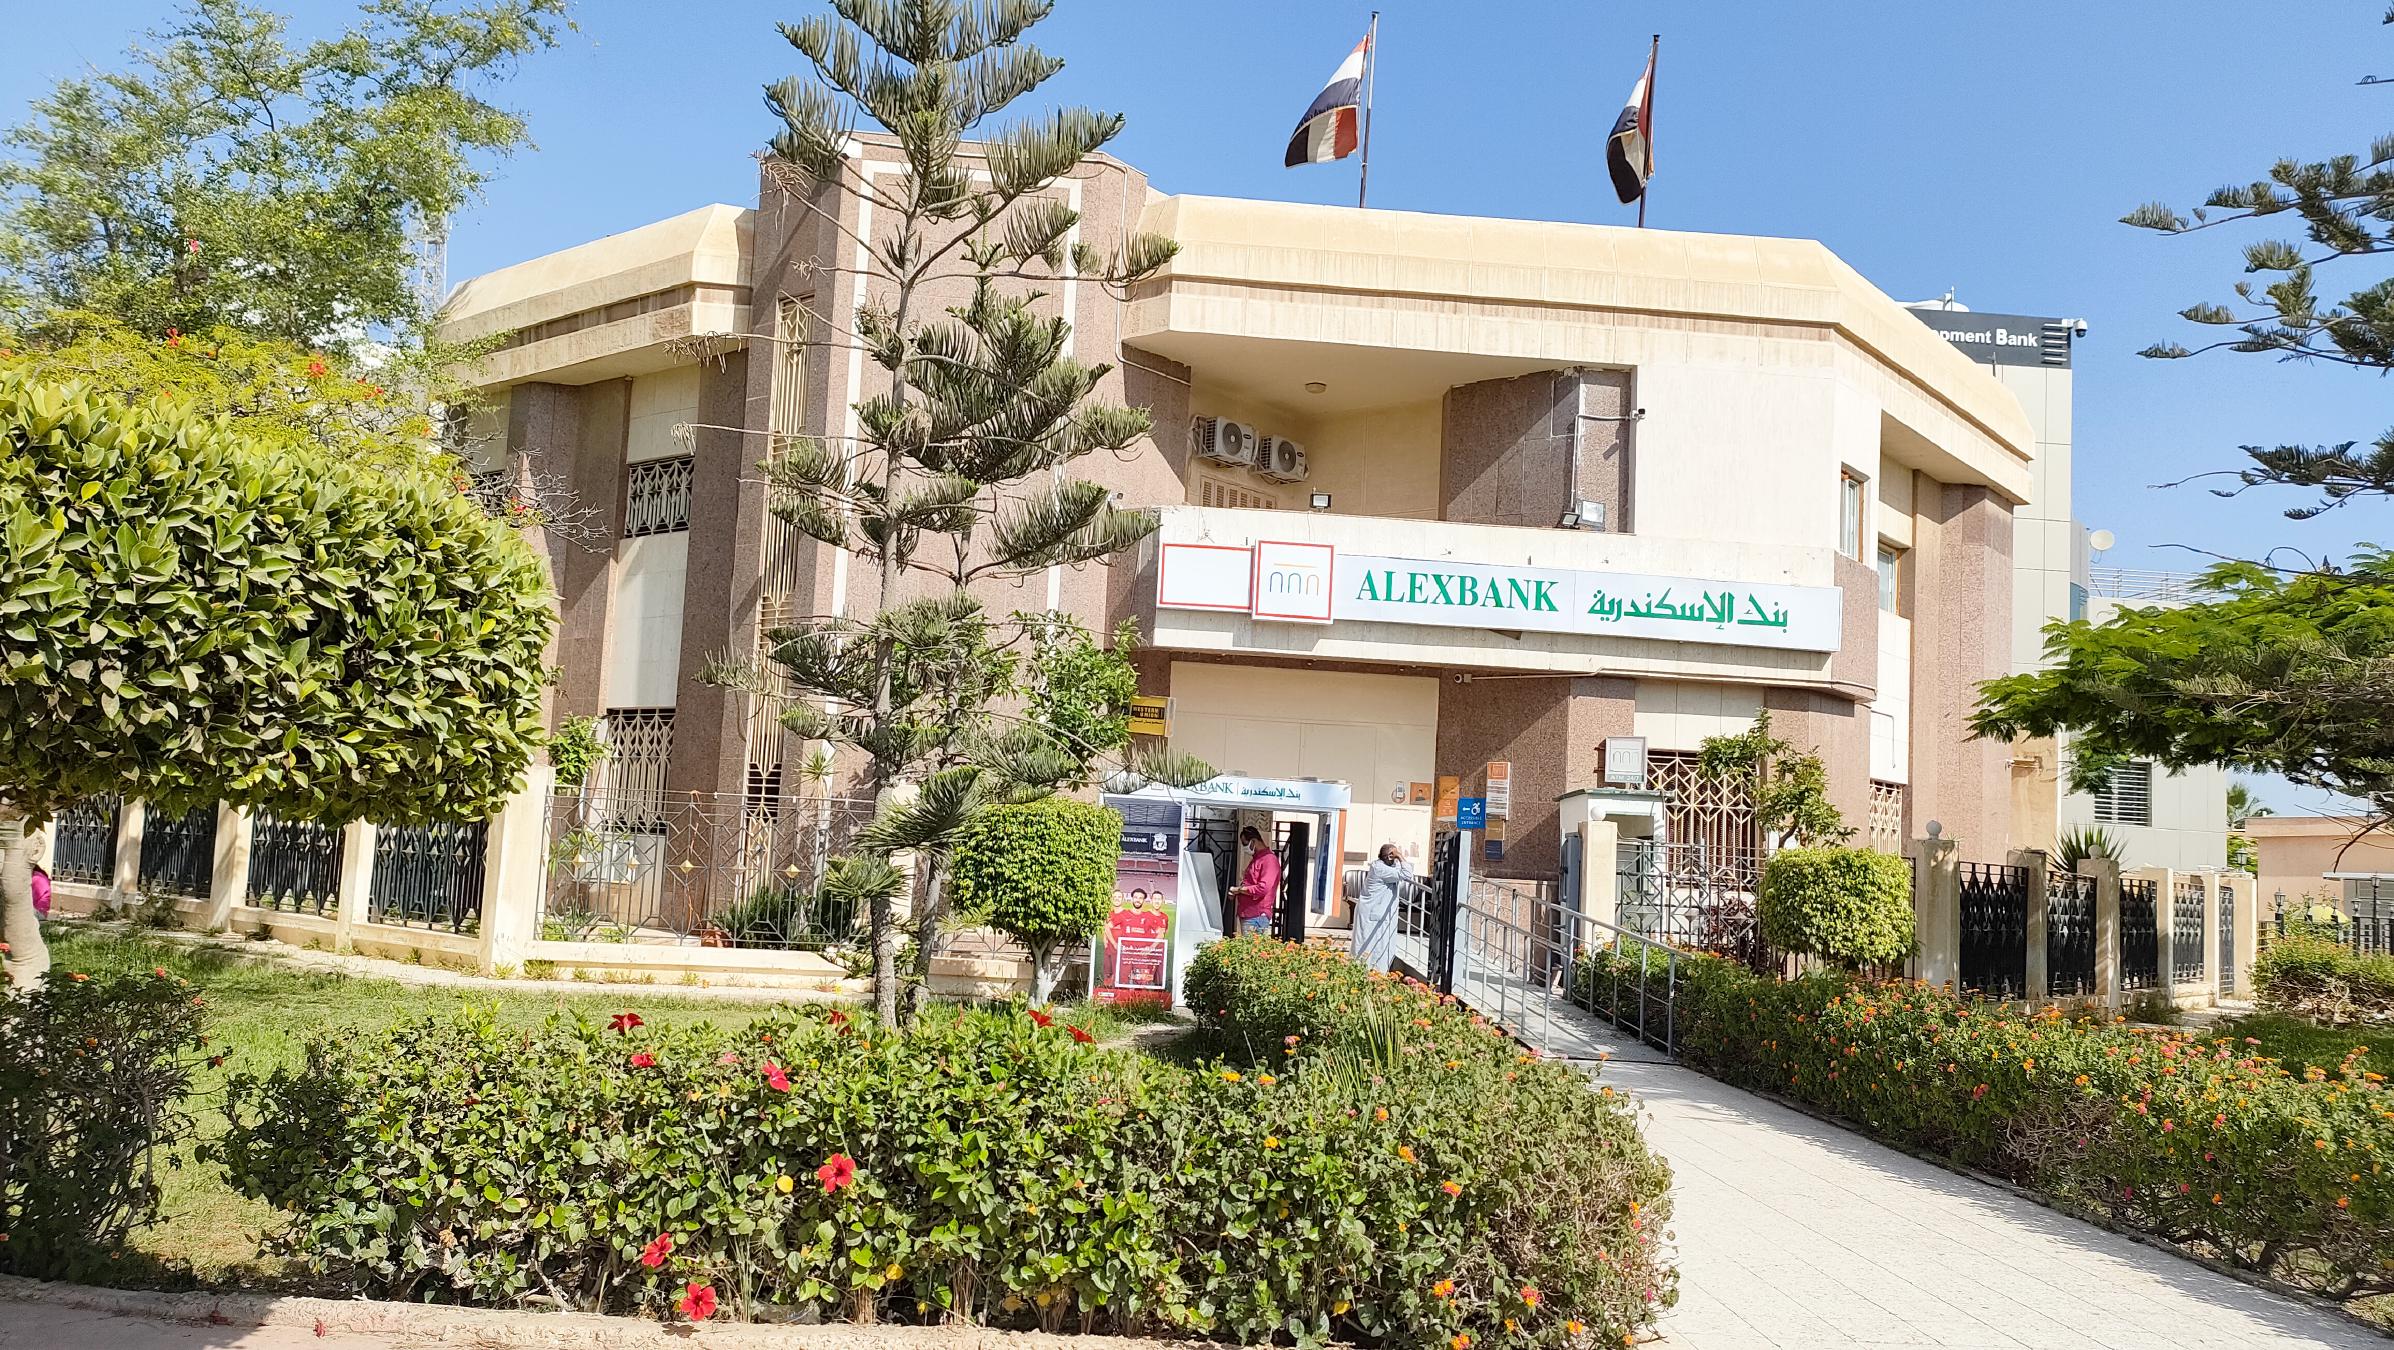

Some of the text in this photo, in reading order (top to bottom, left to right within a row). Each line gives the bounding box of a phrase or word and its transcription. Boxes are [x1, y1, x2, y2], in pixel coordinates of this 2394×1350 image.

[1995, 328, 2038, 347] Bank
[1355, 569, 1559, 612] ALEXBANK
[1737, 592, 1788, 633] بنك
[1286, 787, 1301, 800] بنك
